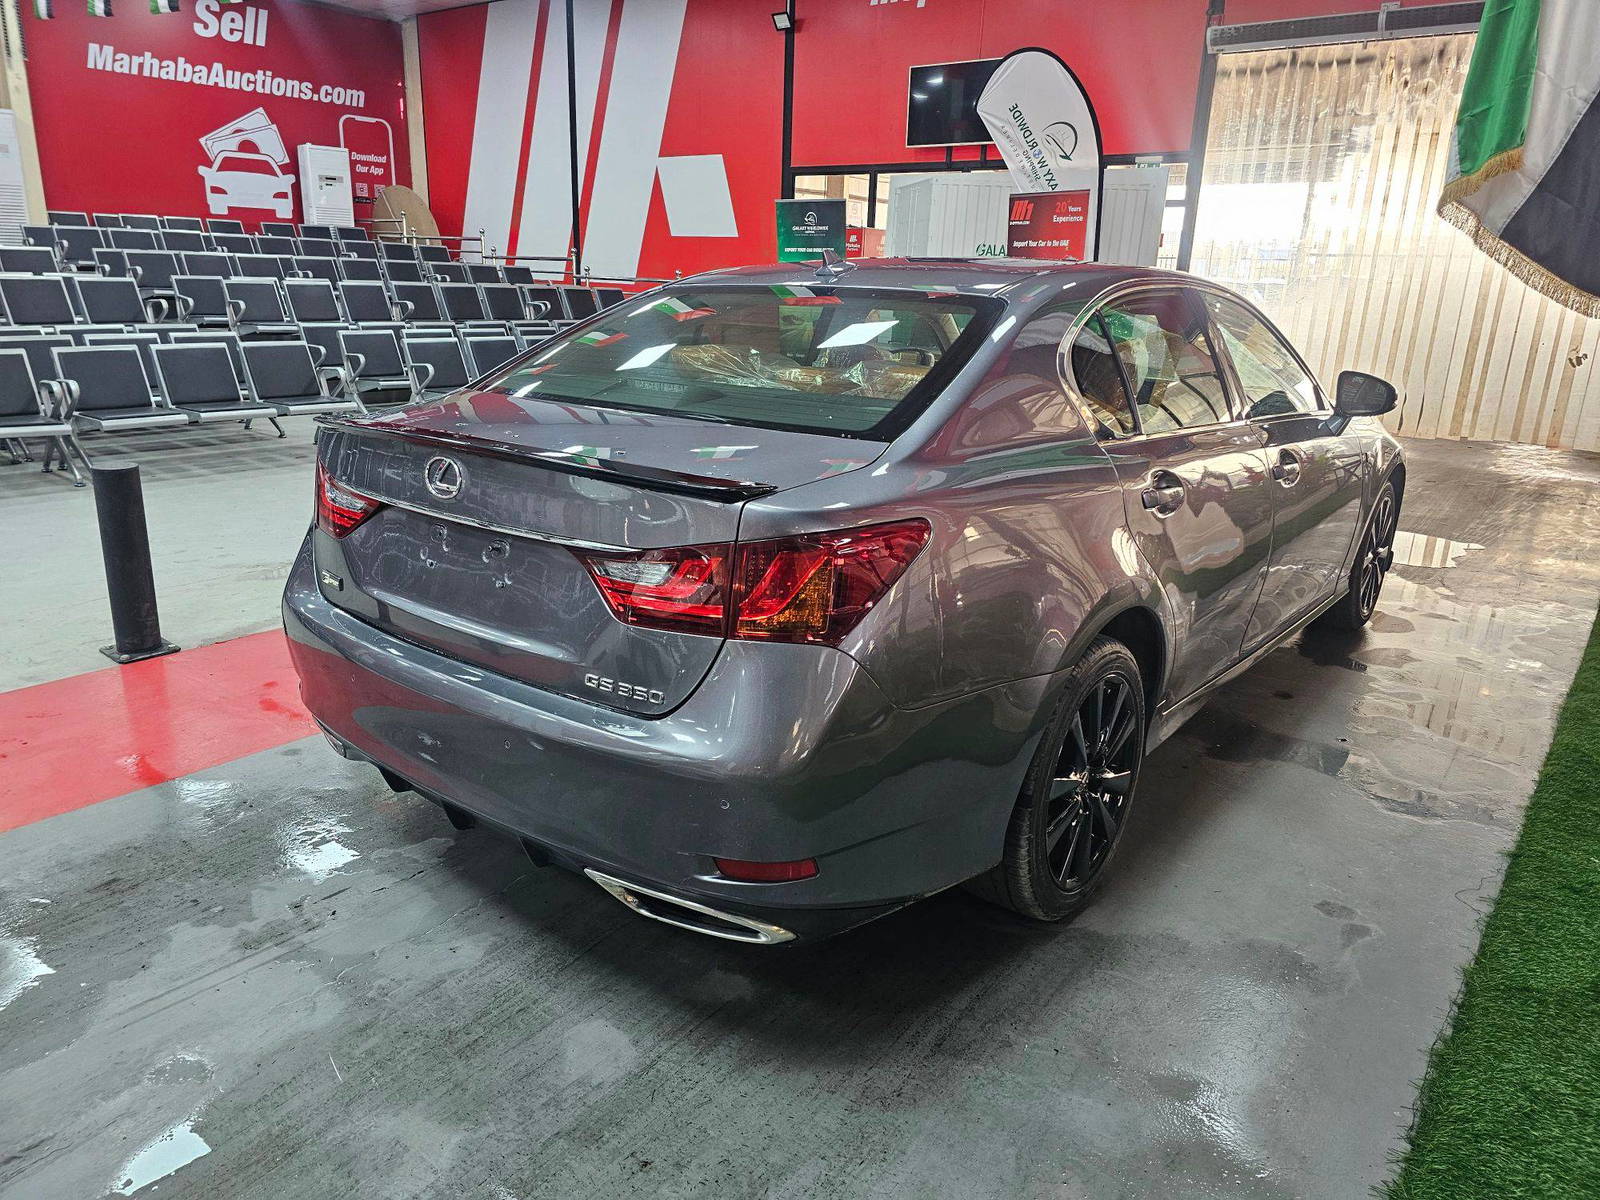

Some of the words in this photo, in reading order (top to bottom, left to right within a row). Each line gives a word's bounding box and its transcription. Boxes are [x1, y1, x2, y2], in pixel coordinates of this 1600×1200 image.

[193, 0, 268, 47] Sell
[86, 42, 365, 108] MarhabaAuctions.com
[351, 151, 387, 163] Download
[355, 164, 368, 173] Our
[369, 165, 384, 175] App
[1053, 215, 1084, 223] Experience
[976, 242, 1006, 257] GALA
[1028, 239, 1038, 247] Your
[1038, 239, 1046, 247] Car
[585, 673, 614, 692] GS
[618, 682, 665, 704] 350
